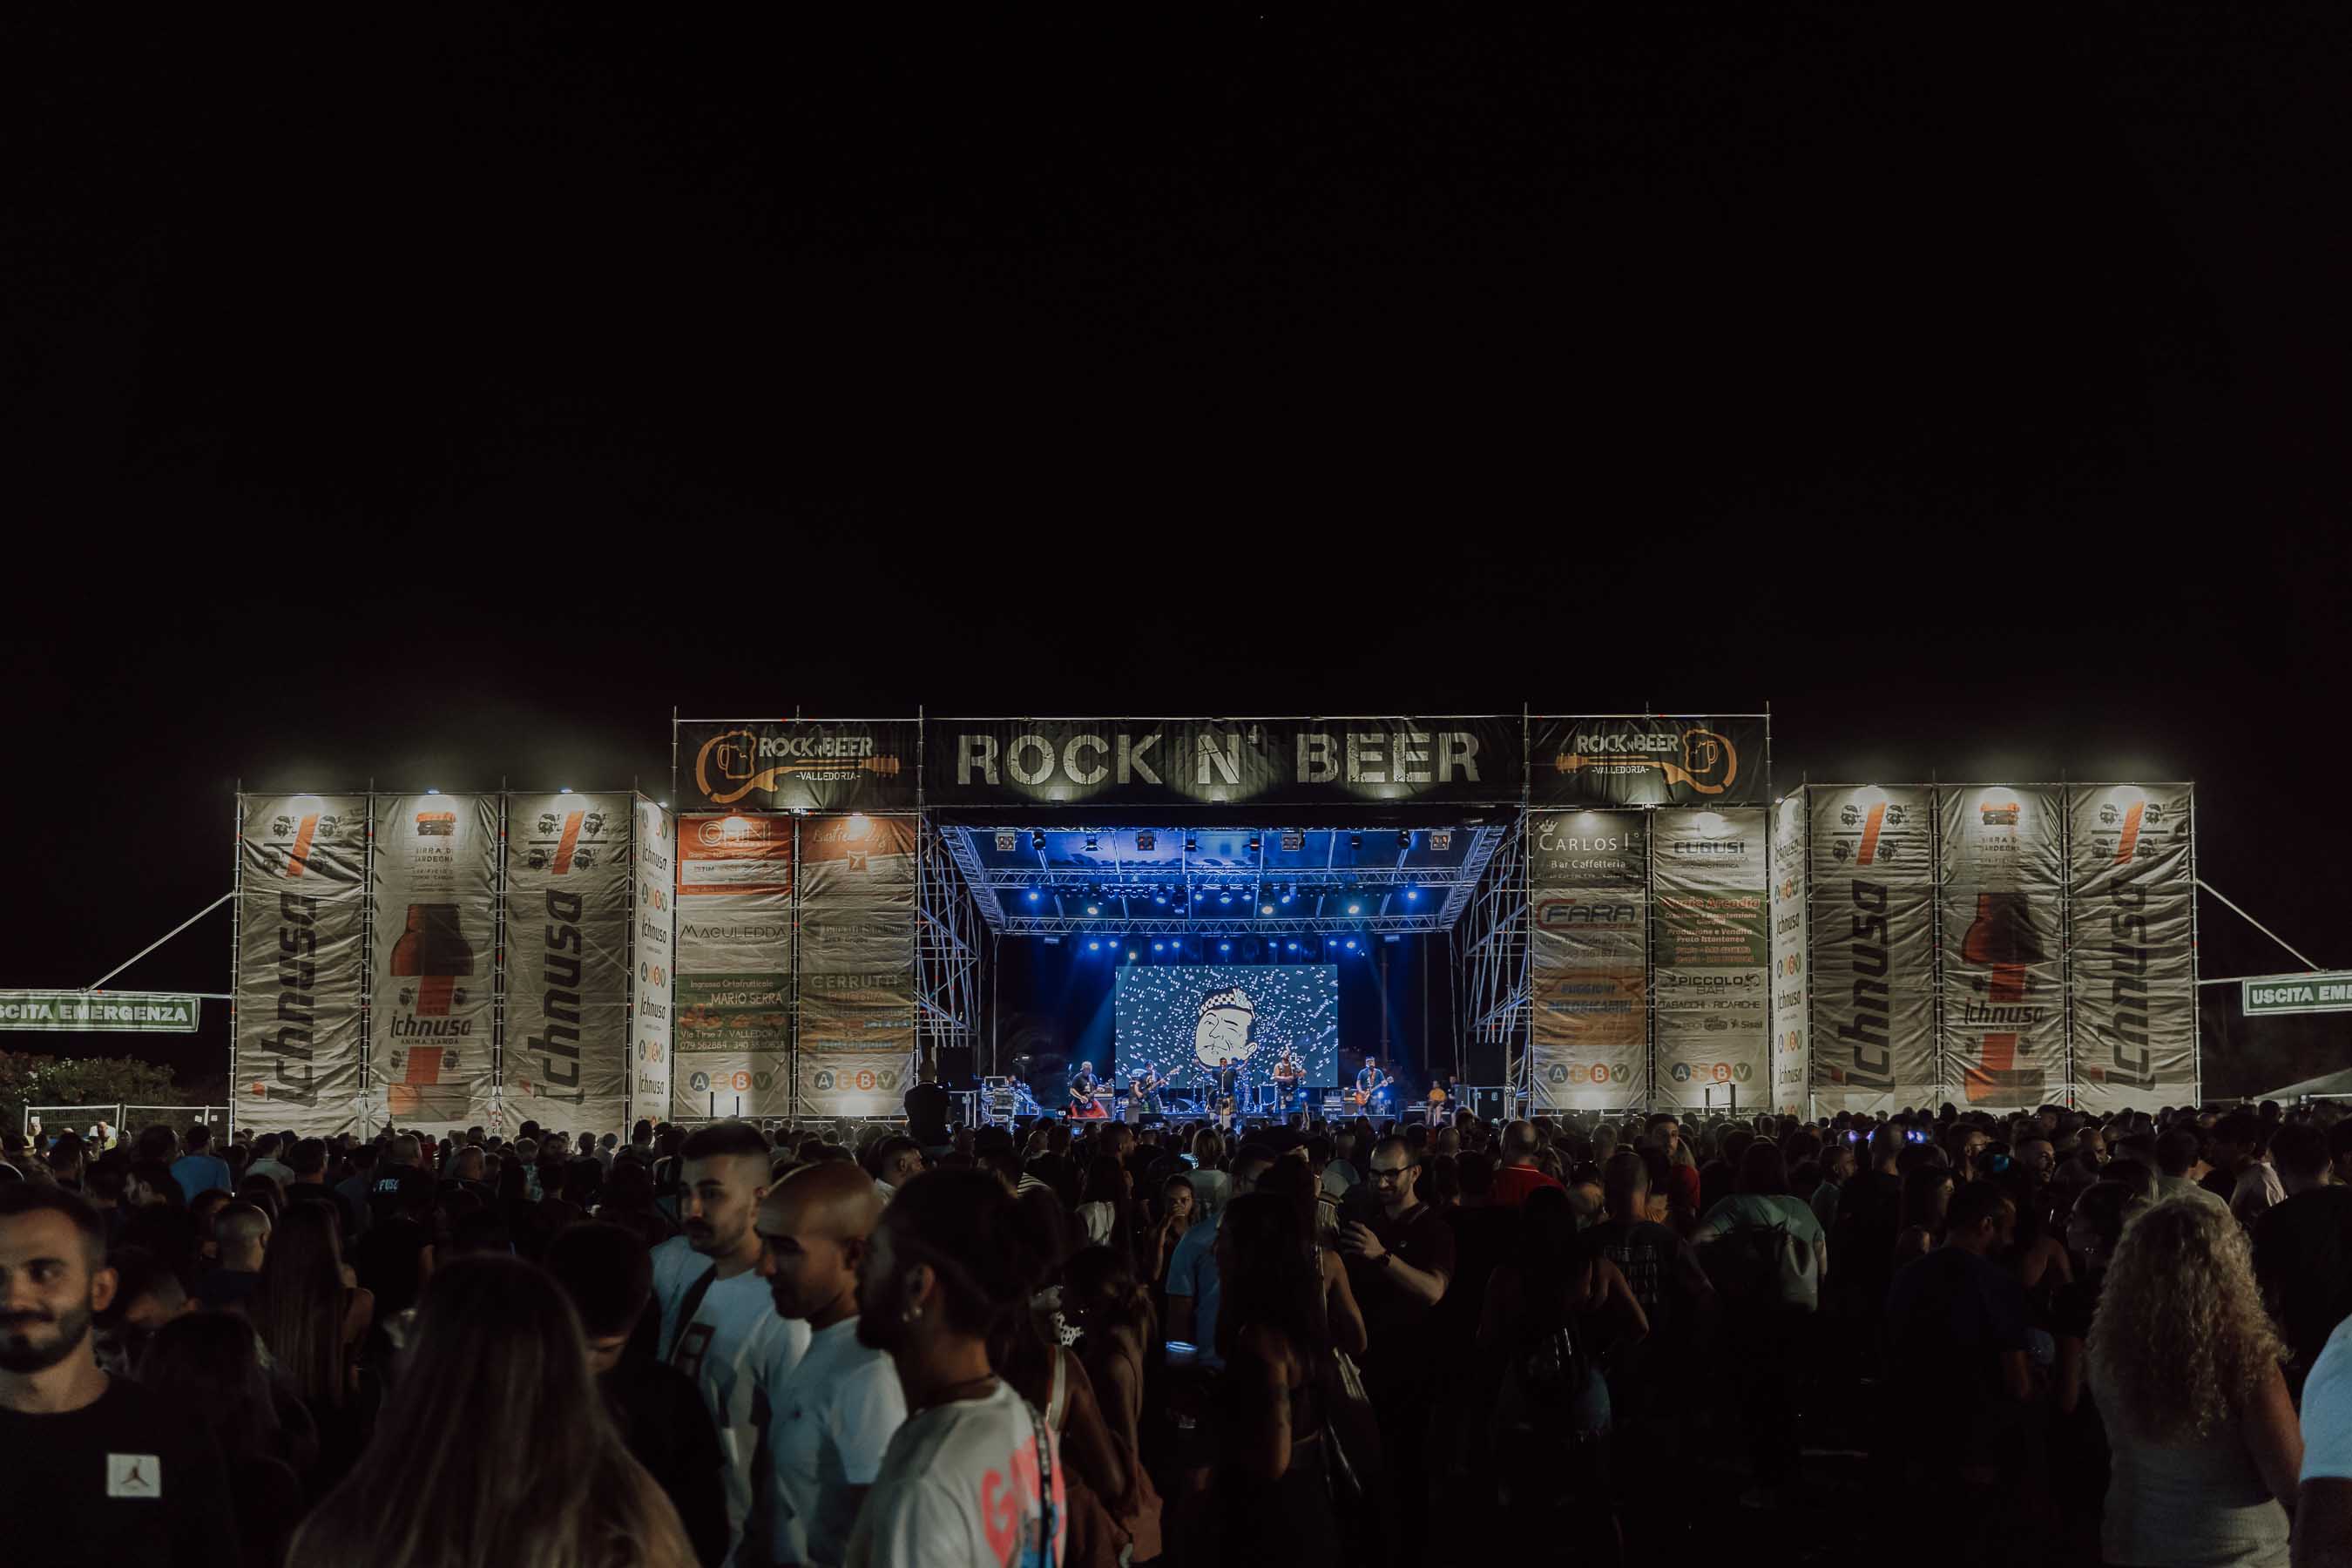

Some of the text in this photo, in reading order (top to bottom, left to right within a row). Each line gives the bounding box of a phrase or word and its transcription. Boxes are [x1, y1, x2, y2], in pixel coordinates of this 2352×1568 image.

[760, 737, 813, 757] ROCK
[823, 737, 873, 757] BEER
[1578, 734, 1626, 754] ROCK
[1635, 733, 1679, 752] BEER
[958, 734, 1163, 784] ROCK
[1297, 732, 1482, 783] BEER
[1679, 976, 1743, 985] PICCOLO
[711, 992, 783, 1004] MARIO SERRA
[2252, 986, 2315, 1004] USCITA
[60, 1004, 188, 1022] EMERGENZA
